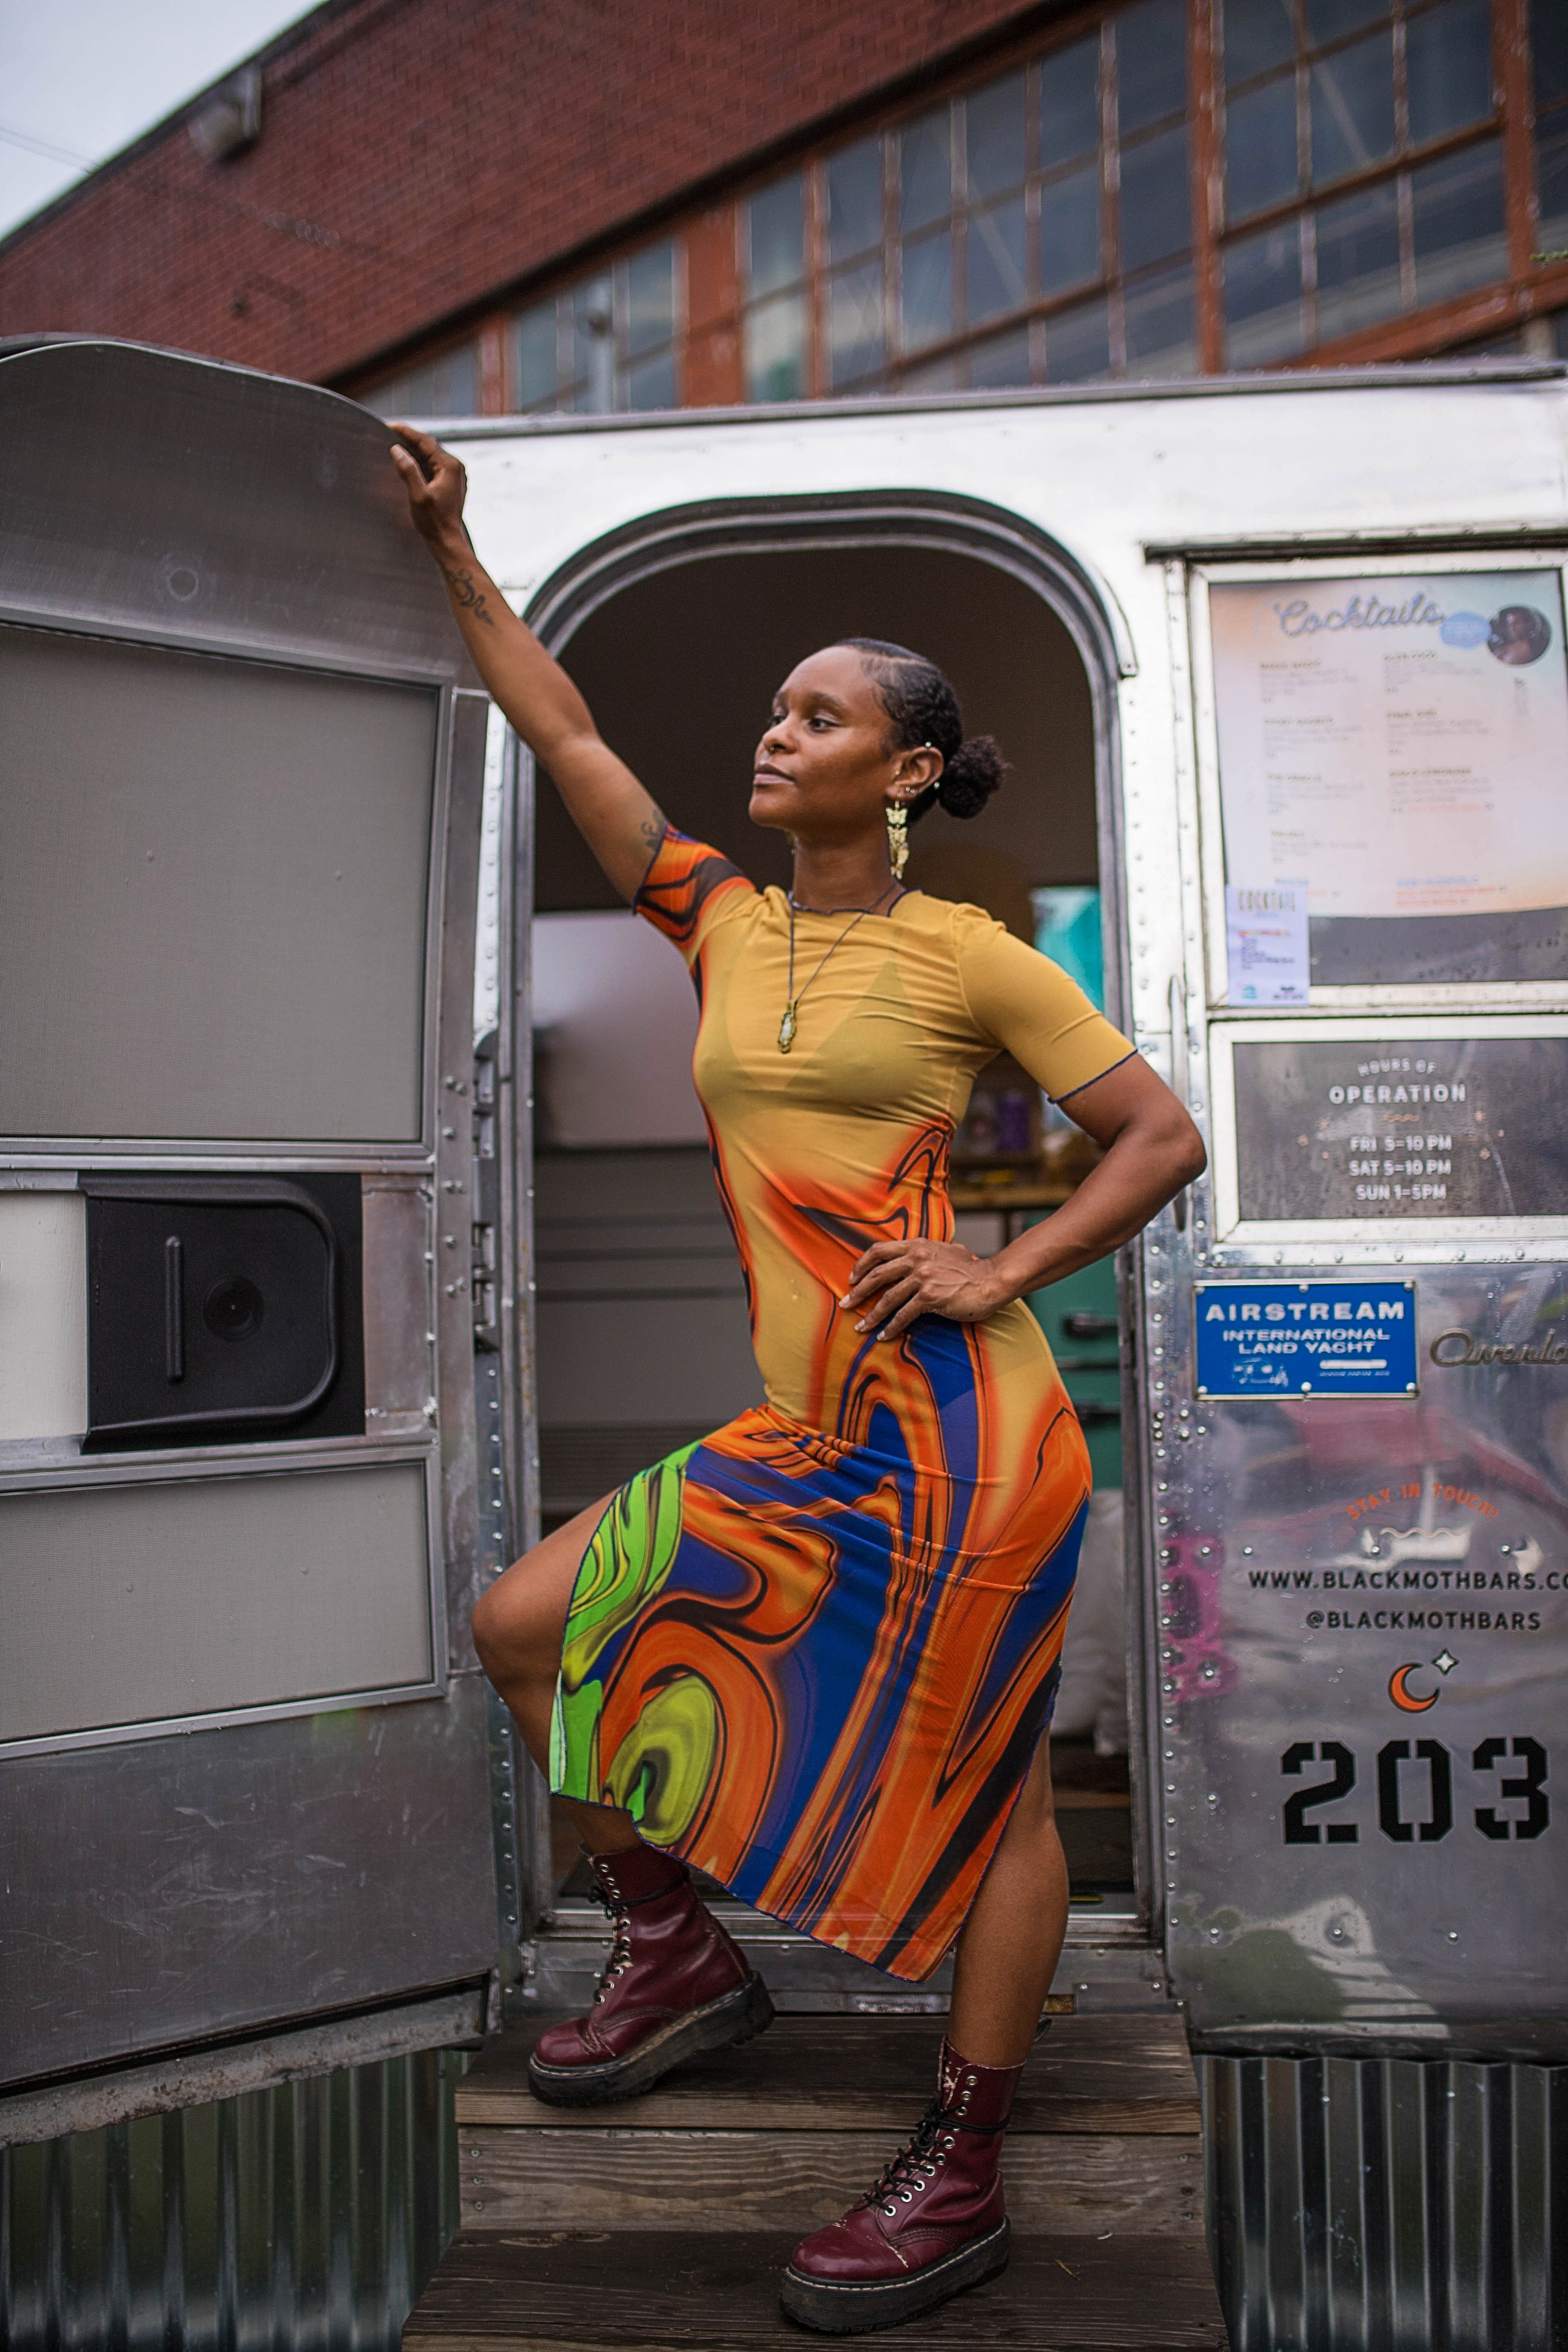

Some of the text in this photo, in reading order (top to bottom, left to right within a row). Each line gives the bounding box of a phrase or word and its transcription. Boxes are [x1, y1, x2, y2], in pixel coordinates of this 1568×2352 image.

[1273, 592, 1446, 636] Cocktails
[1357, 1058, 1436, 1077] HOURS OF
[1329, 1084, 1466, 1104] OPERATION
[1350, 1136, 1377, 1152] FRI
[1427, 1134, 1452, 1151] PM
[1349, 1160, 1379, 1176] SAT
[1426, 1159, 1452, 1175] PM
[1355, 1184, 1390, 1200] SUN
[1205, 1302, 1404, 1321] AIRSTREAM
[1223, 1328, 1390, 1341] INTERNATIONAL
[1238, 1341, 1376, 1354] LAND YACHT
[1347, 1483, 1500, 1522] STAY IN TOUCH!
[1306, 1611, 1541, 1630] @BLACKMOTHBARS
[1280, 1737, 1550, 1844] 203
